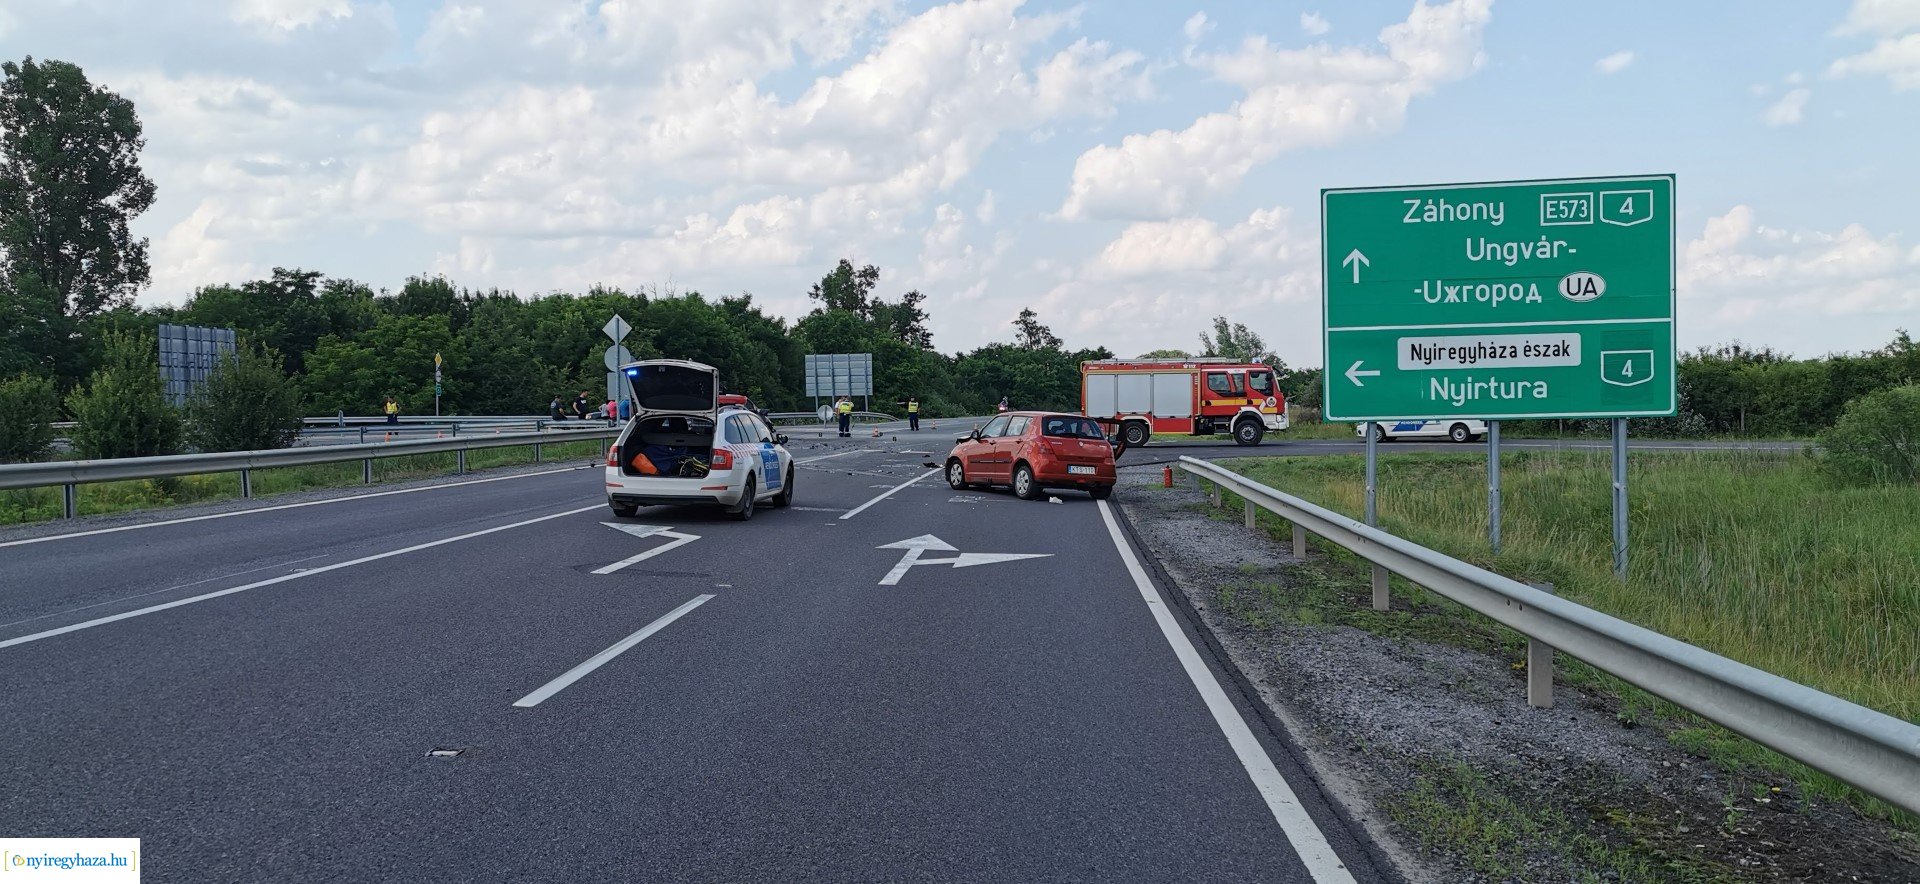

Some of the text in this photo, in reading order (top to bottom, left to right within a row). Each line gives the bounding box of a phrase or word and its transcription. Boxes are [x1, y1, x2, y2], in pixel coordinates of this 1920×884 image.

[1403, 198, 1504, 226] Záhony
[1546, 200, 1588, 218] E573
[1619, 196, 1634, 215] 4
[1466, 236, 1577, 266] Ungvár-
[1566, 277, 1598, 297] UA
[1523, 340, 1571, 358] észak
[1621, 359, 1633, 378] 4
